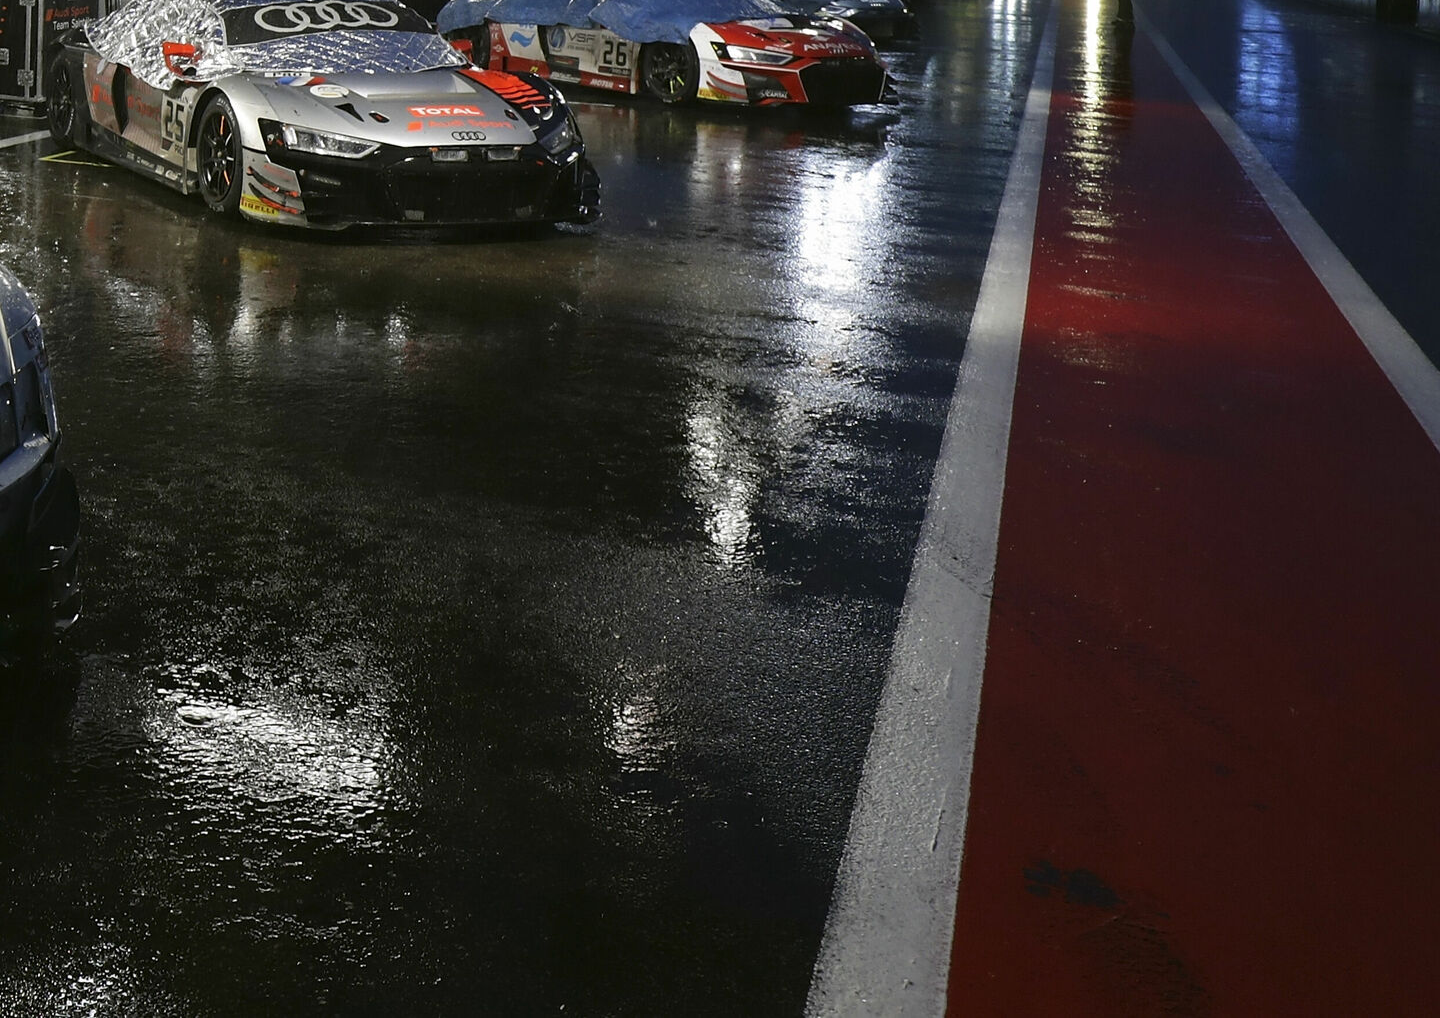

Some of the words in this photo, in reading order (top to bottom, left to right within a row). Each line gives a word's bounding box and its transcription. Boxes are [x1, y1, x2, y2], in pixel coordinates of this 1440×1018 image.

[53, 20, 70, 30] Team
[603, 40, 628, 66] 26
[410, 106, 481, 116] TOTAL
[166, 99, 185, 143] 25
